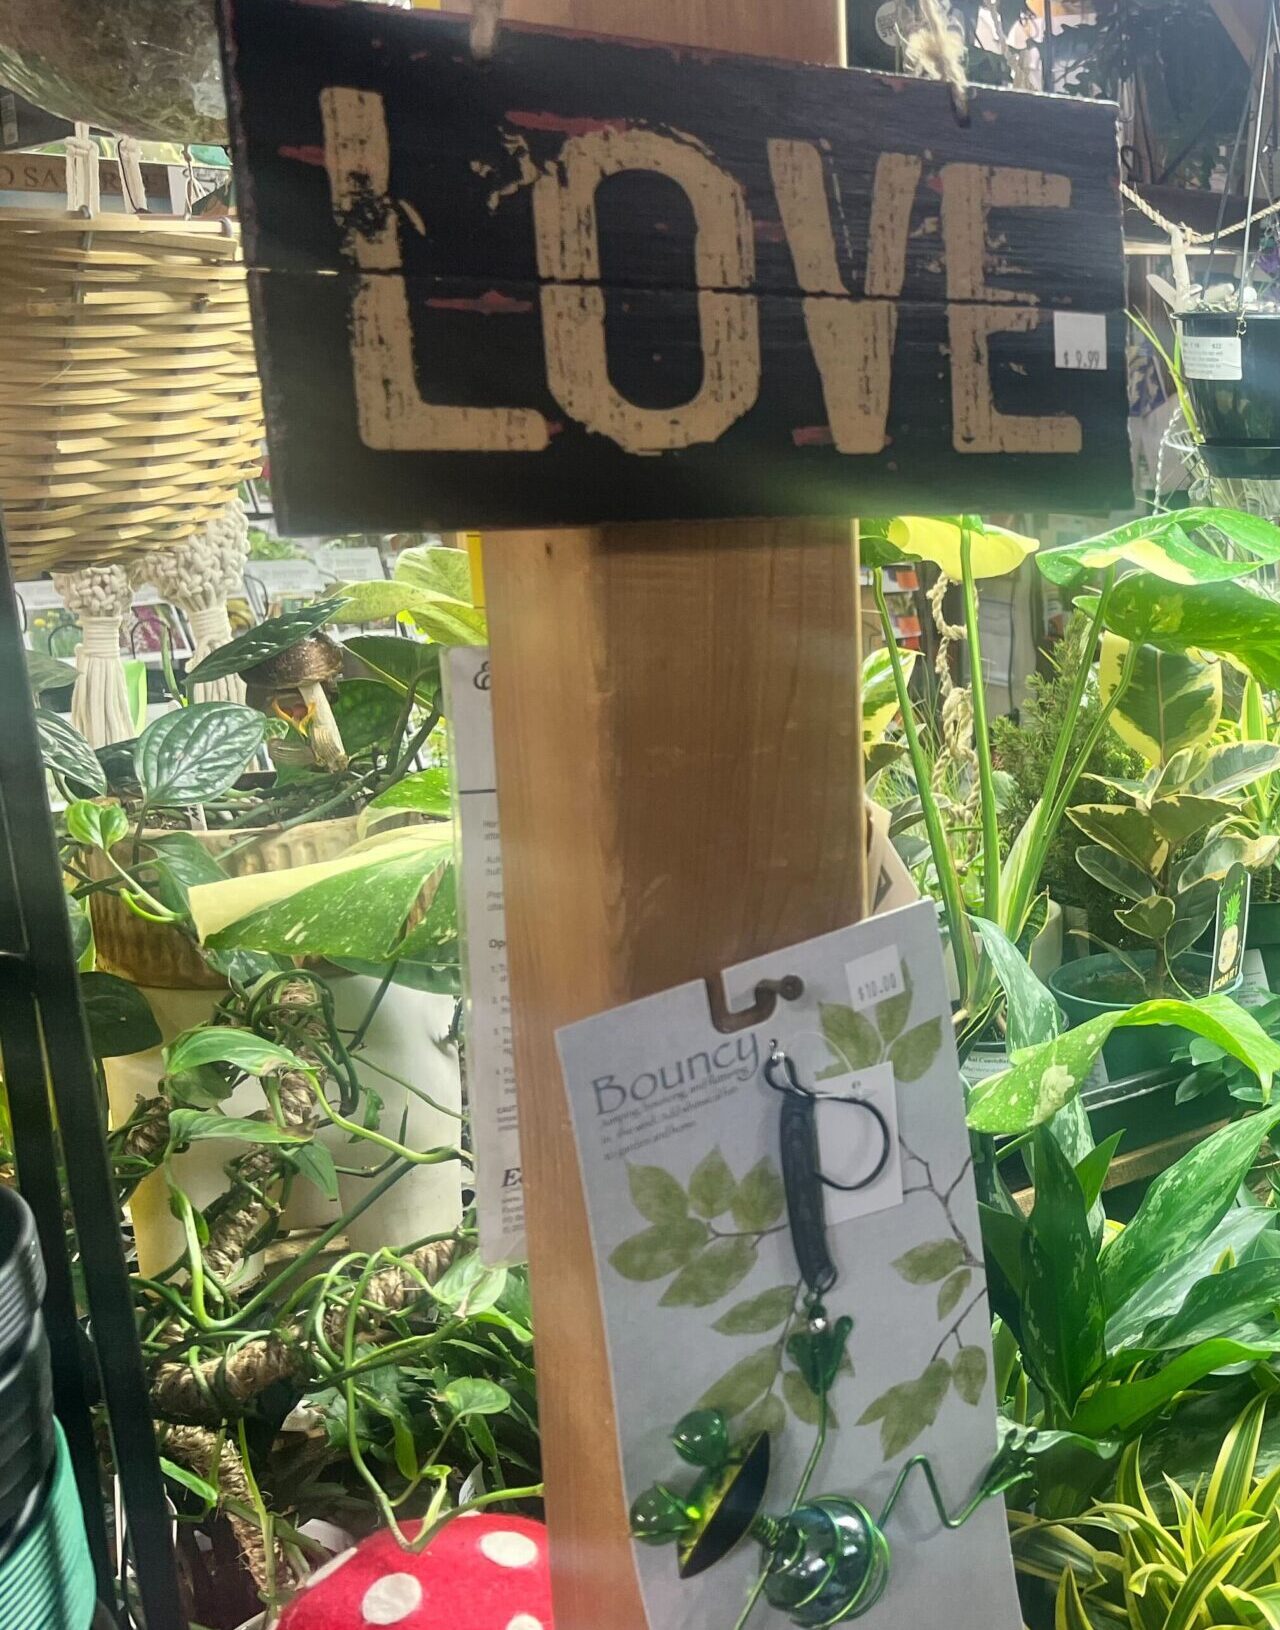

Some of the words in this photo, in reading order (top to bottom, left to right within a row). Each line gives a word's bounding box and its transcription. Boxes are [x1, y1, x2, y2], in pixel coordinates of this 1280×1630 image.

[319, 86, 1083, 457] LOVE
[857, 972, 897, 1002] $10.00
[592, 1033, 759, 1115] Bouncy
